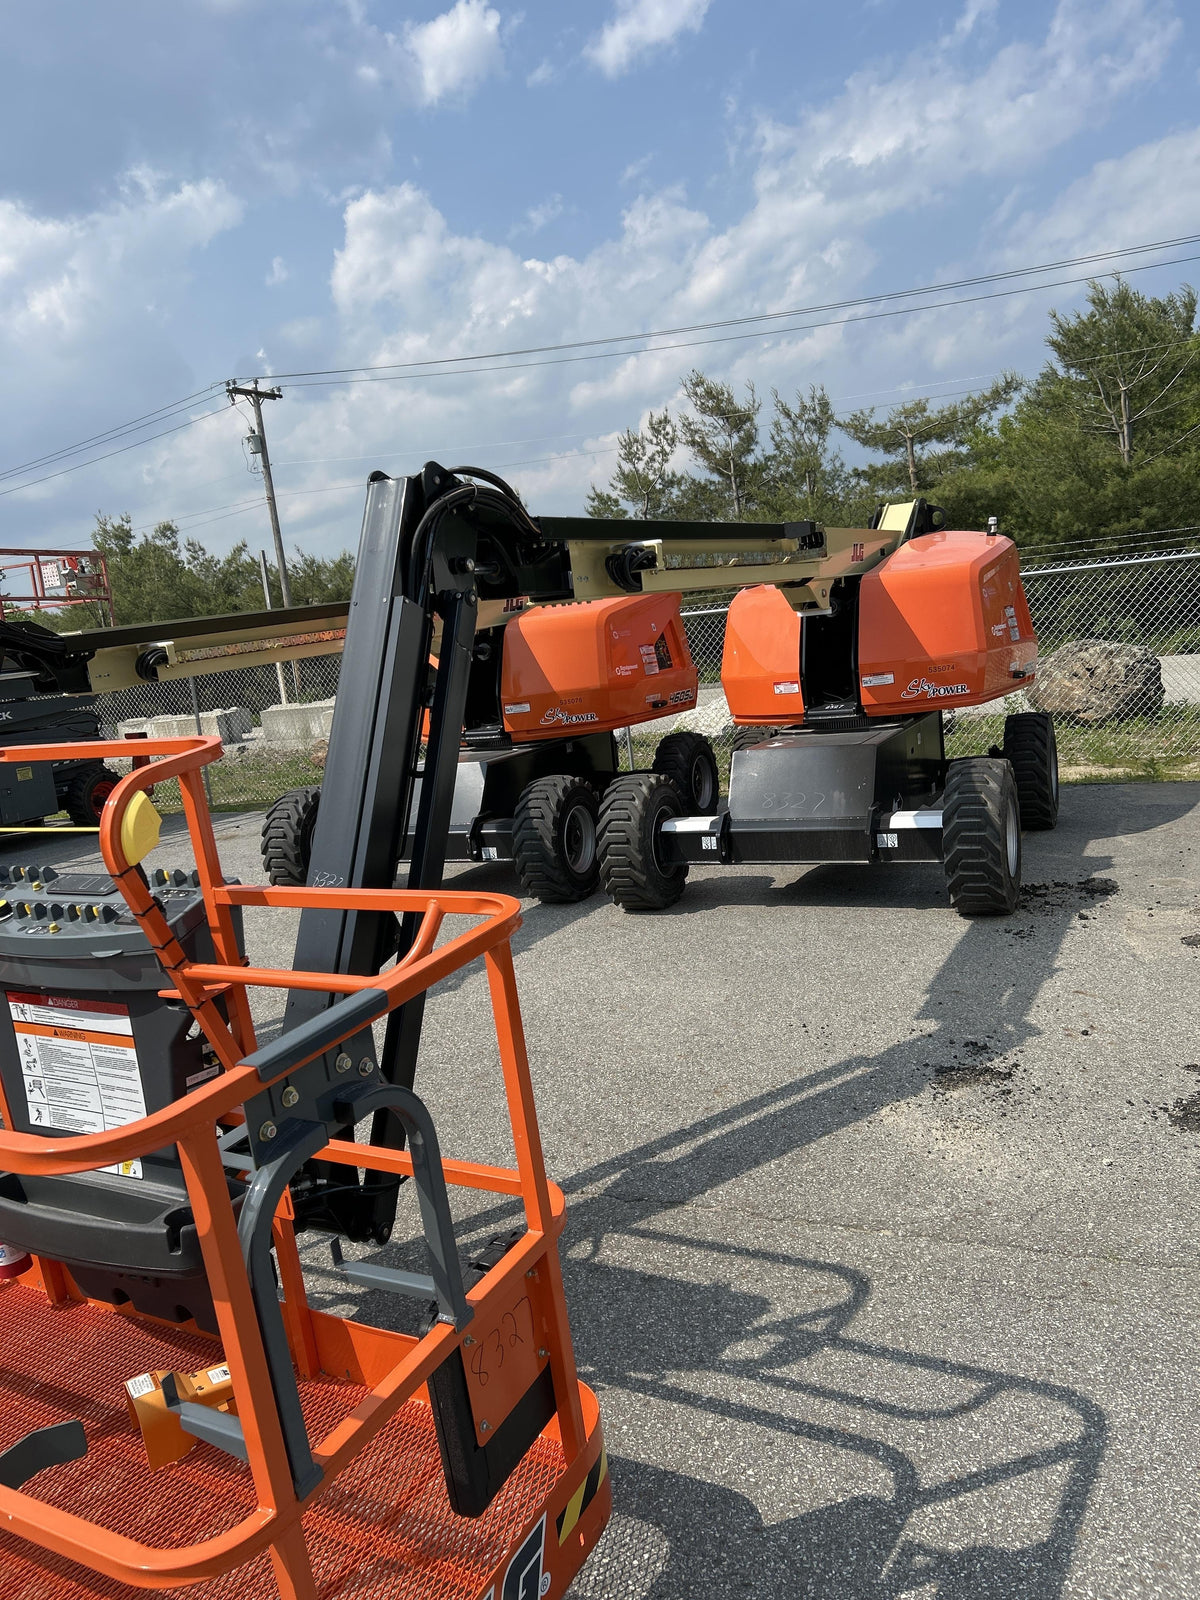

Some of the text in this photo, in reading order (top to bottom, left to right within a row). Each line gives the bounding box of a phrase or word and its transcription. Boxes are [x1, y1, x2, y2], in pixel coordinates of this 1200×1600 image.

[851, 543, 865, 562] JLG
[928, 663, 955, 674] 535074
[931, 683, 969, 697] POWER
[761, 792, 826, 814] 8327
[53, 998, 79, 1009] DANGER
[59, 1030, 86, 1040] WARNING
[471, 1295, 535, 1387] 8327
